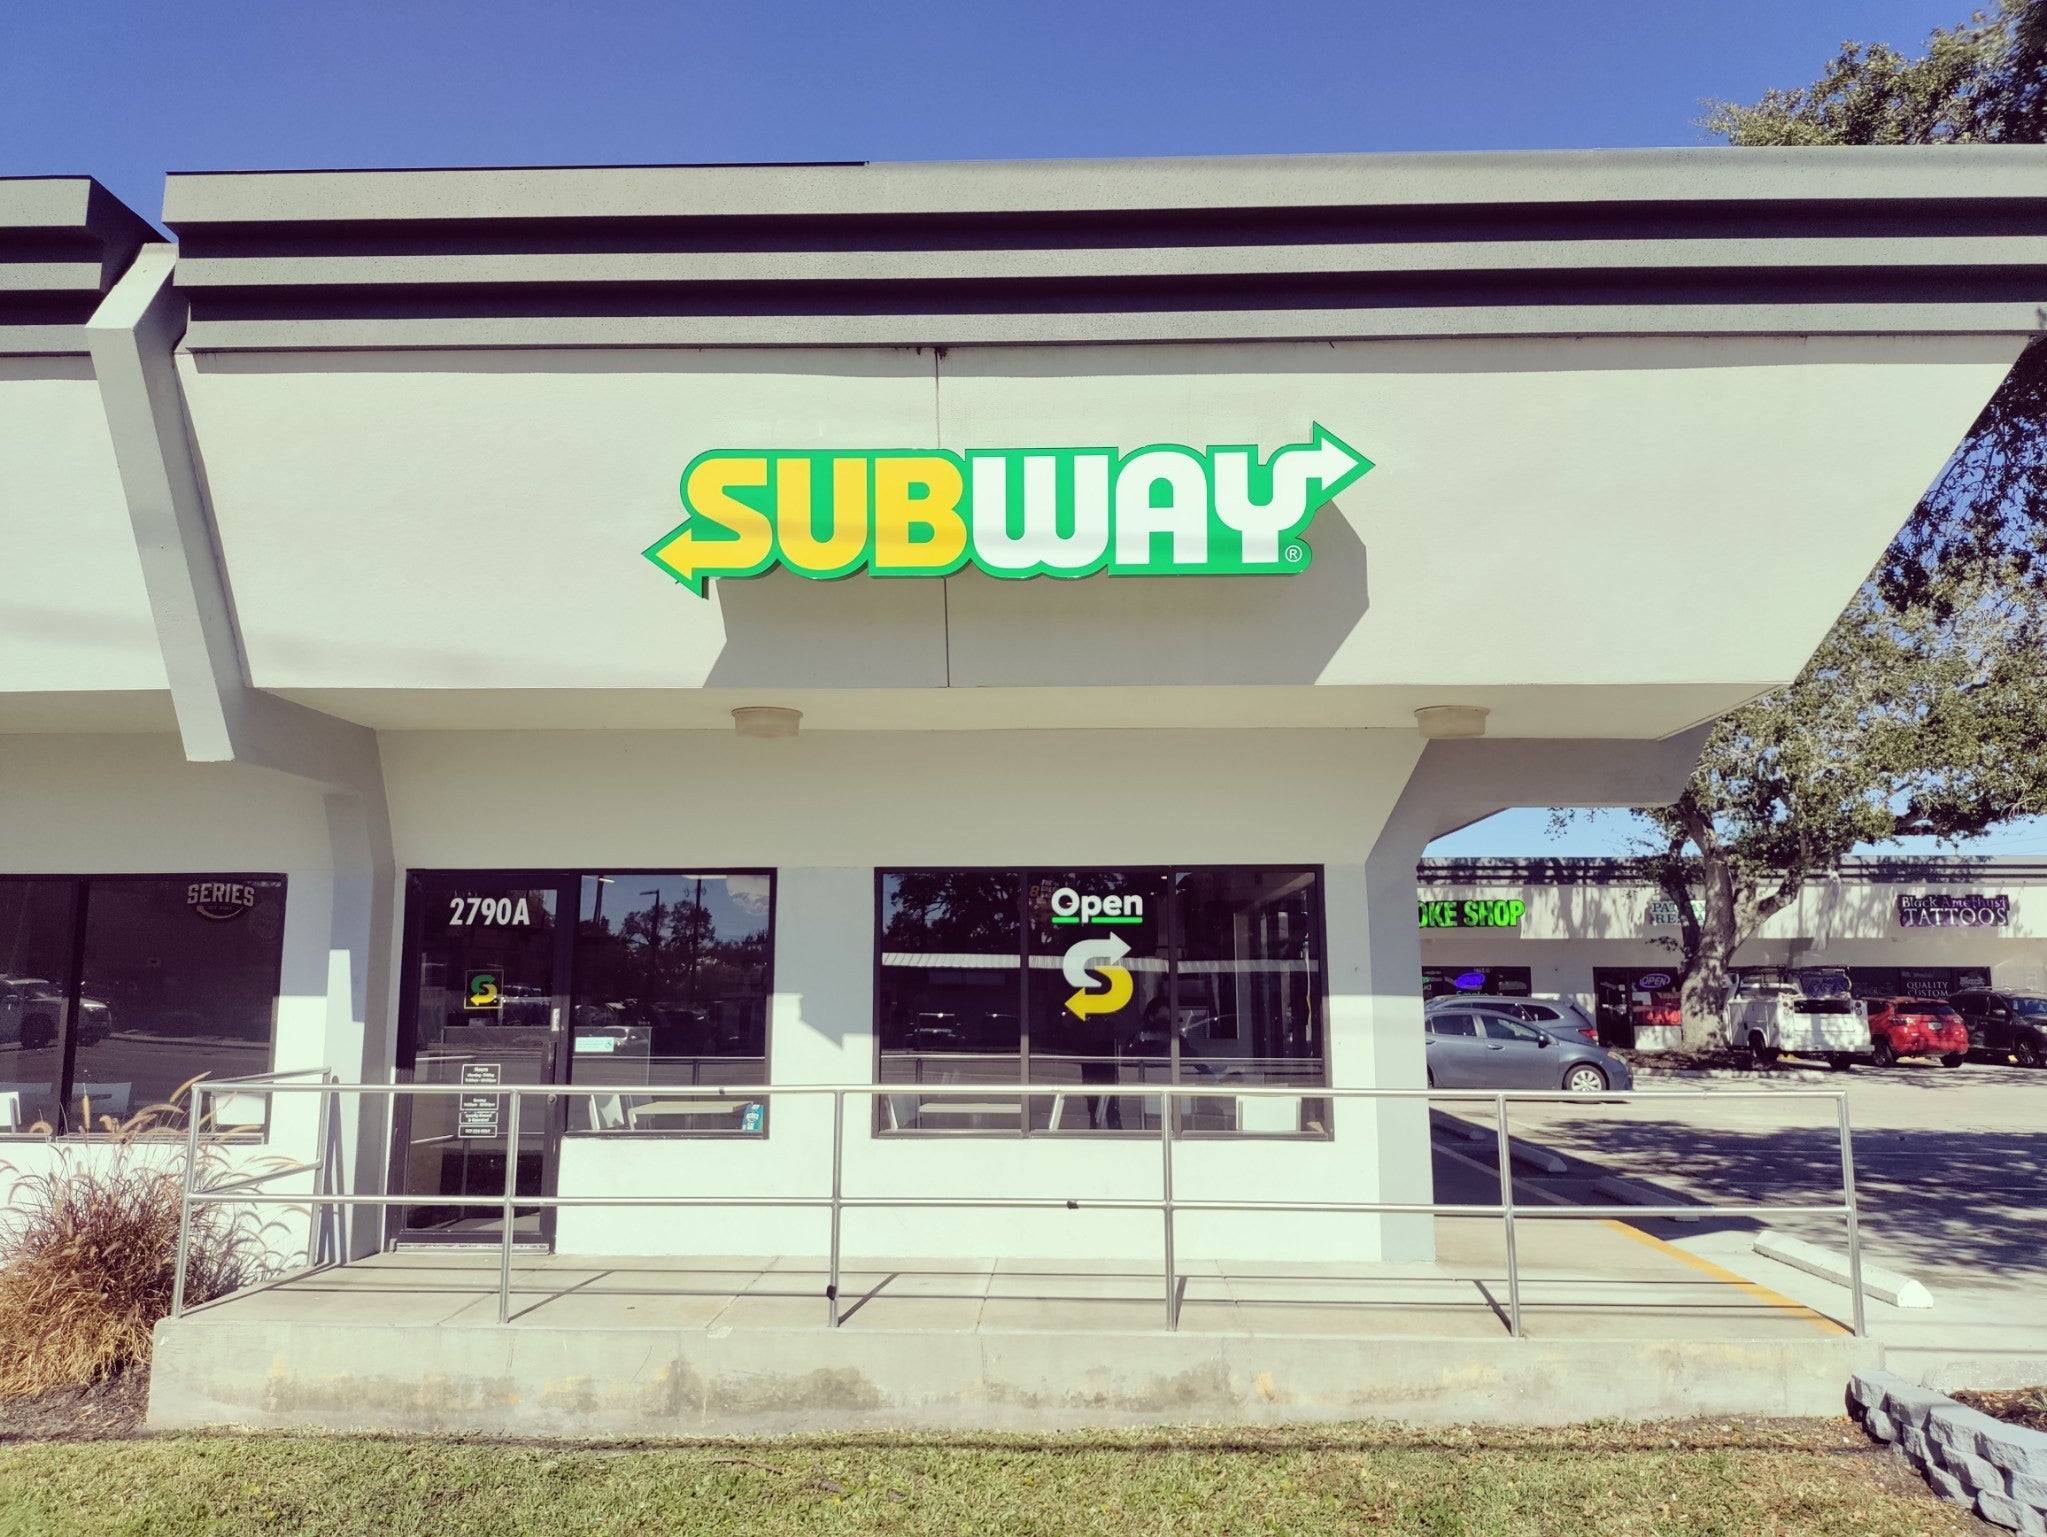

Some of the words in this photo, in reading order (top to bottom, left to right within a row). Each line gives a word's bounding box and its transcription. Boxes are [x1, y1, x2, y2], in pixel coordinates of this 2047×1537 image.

[655, 437, 1359, 587] SUBWAY
[187, 883, 255, 907] SERIES
[1051, 887, 1143, 923] Open
[1902, 896, 1937, 907] Black
[449, 898, 531, 926] 2790A
[1463, 900, 1525, 927] SHOP
[1904, 908, 2007, 926] TATTOOS
[1643, 976, 1667, 986] OPEN
[1907, 981, 1948, 990] QUALITY
